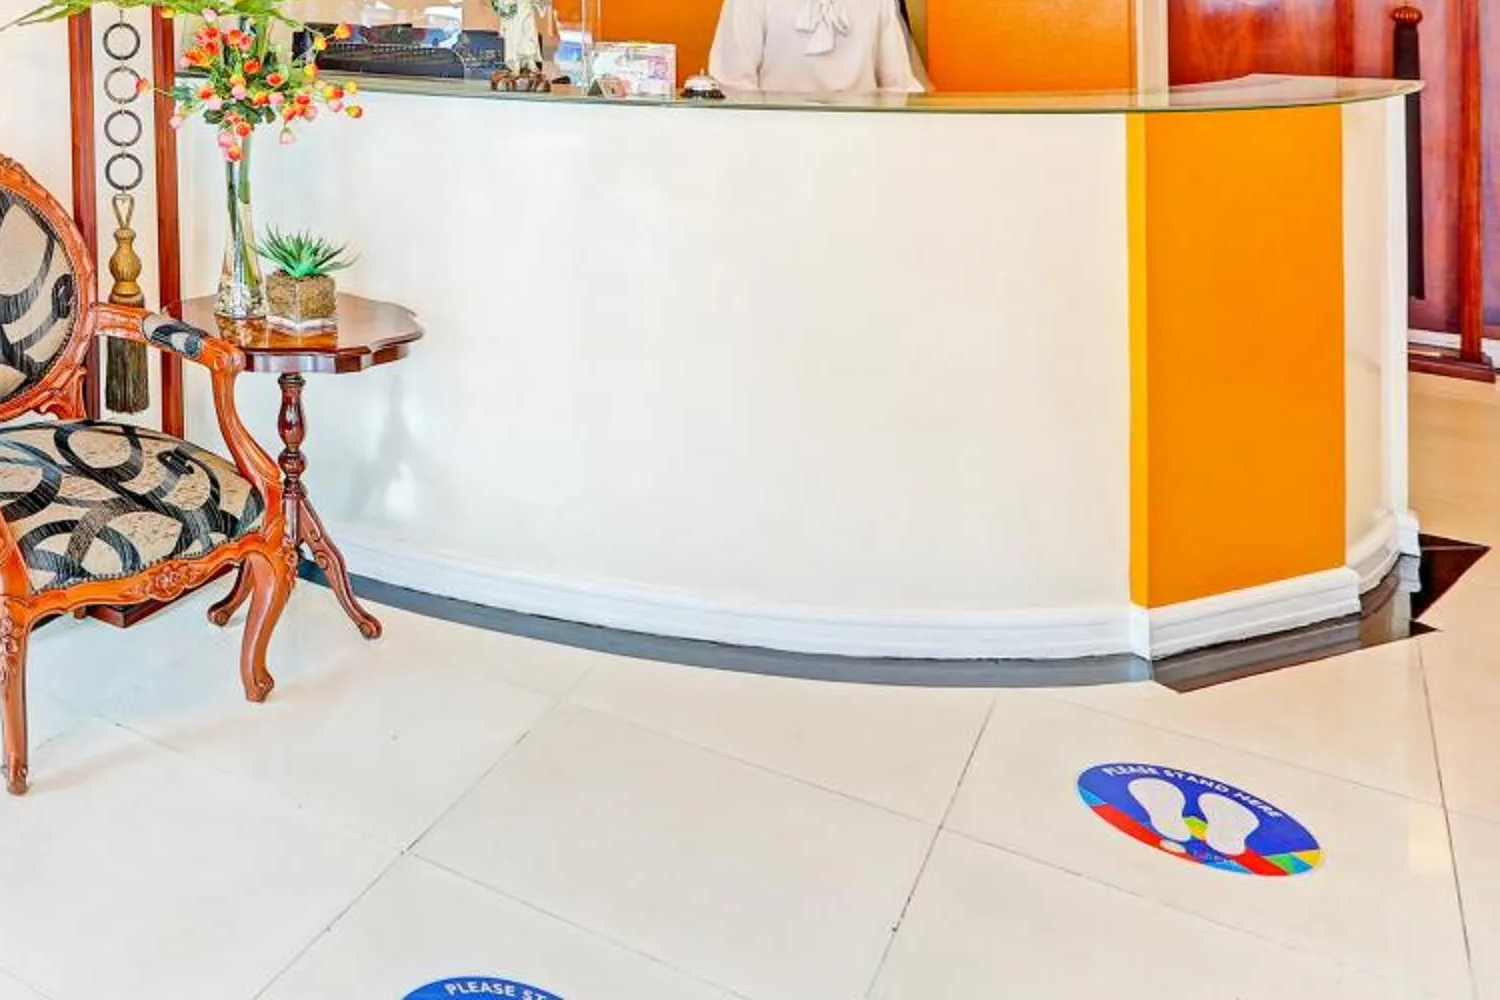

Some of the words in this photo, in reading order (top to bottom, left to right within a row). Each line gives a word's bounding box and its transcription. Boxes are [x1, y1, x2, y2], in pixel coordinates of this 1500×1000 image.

[1101, 765, 1160, 777] PLEASE
[1163, 769, 1229, 792] STAND
[1233, 792, 1285, 818] HERE
[444, 981, 516, 997] PLEASE
